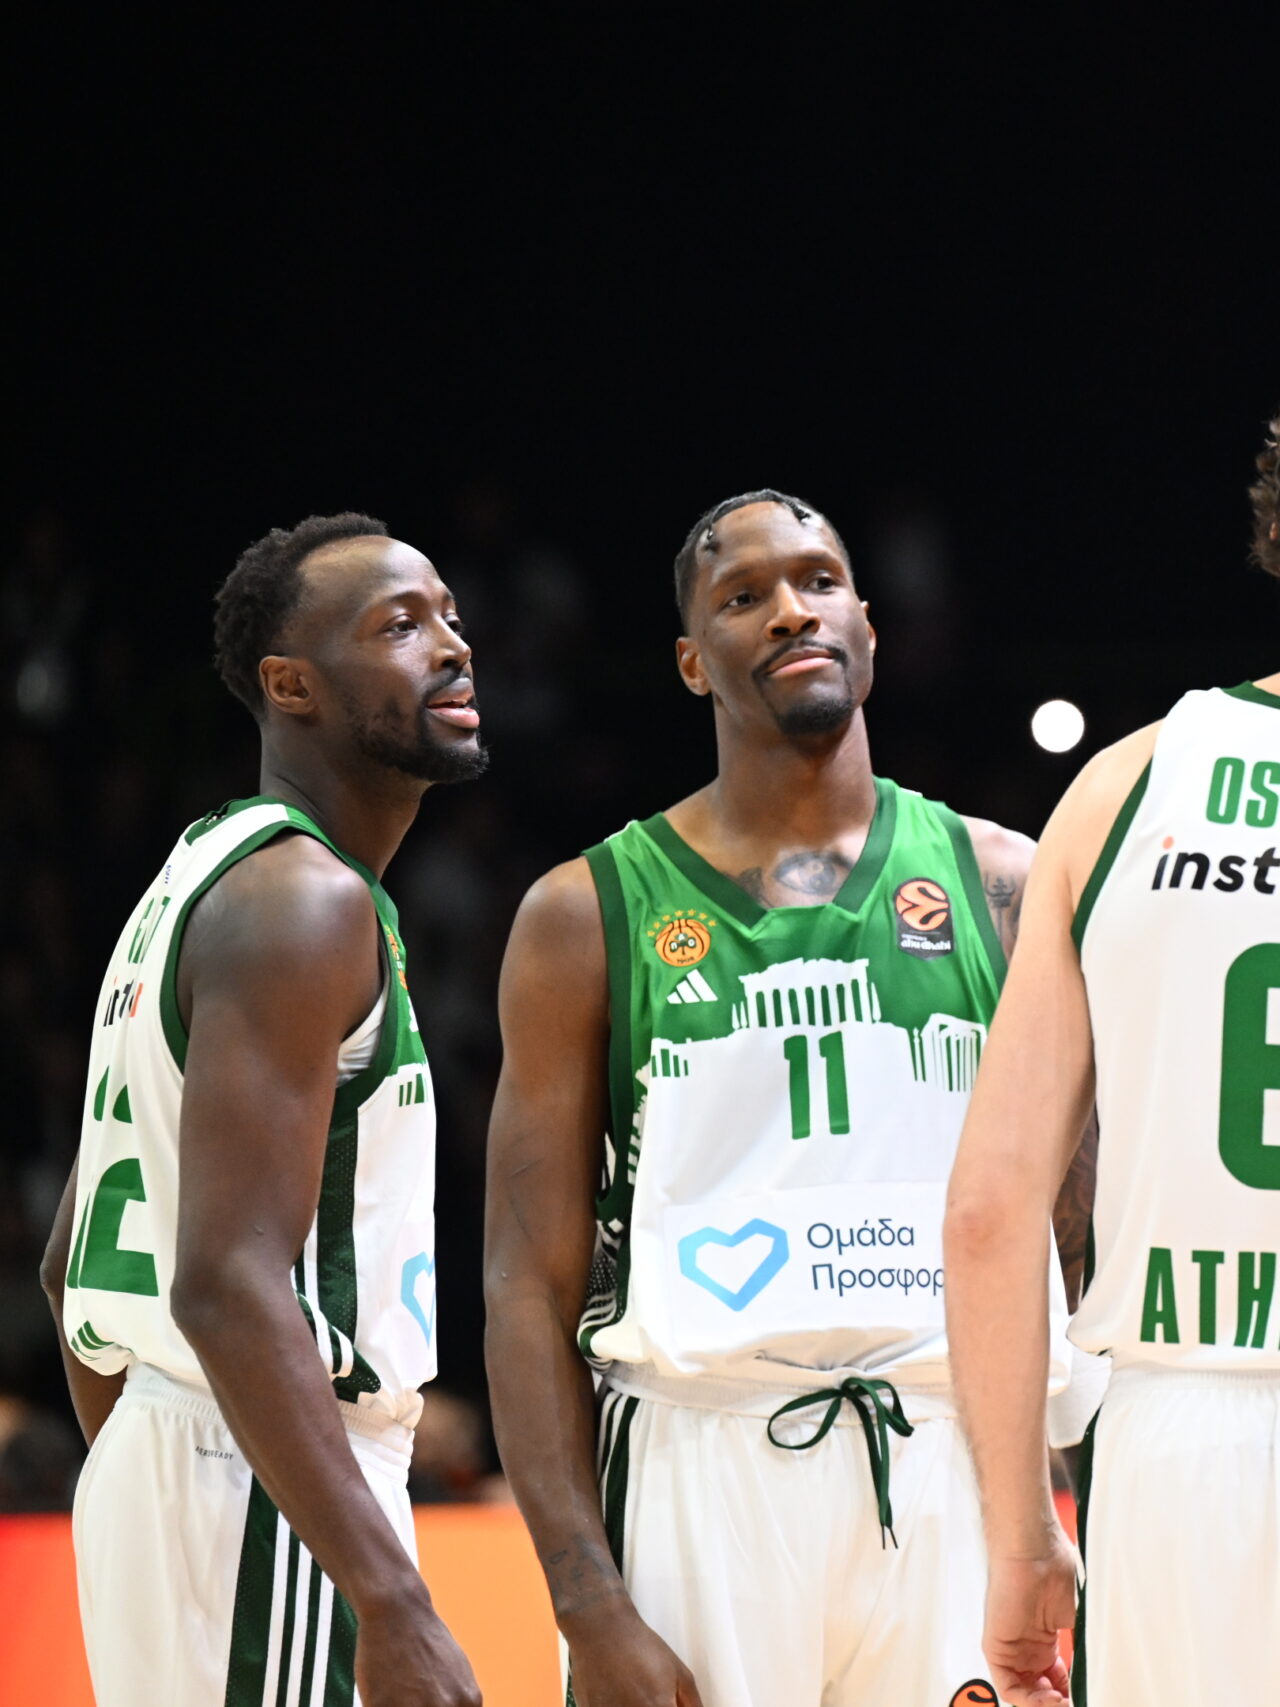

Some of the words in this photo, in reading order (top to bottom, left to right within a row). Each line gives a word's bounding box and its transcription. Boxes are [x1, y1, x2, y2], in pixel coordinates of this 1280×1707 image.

[784, 1031, 851, 1140] 11
[807, 1219, 915, 1256] Ομάδα
[812, 1263, 944, 1297] Προσφορ
